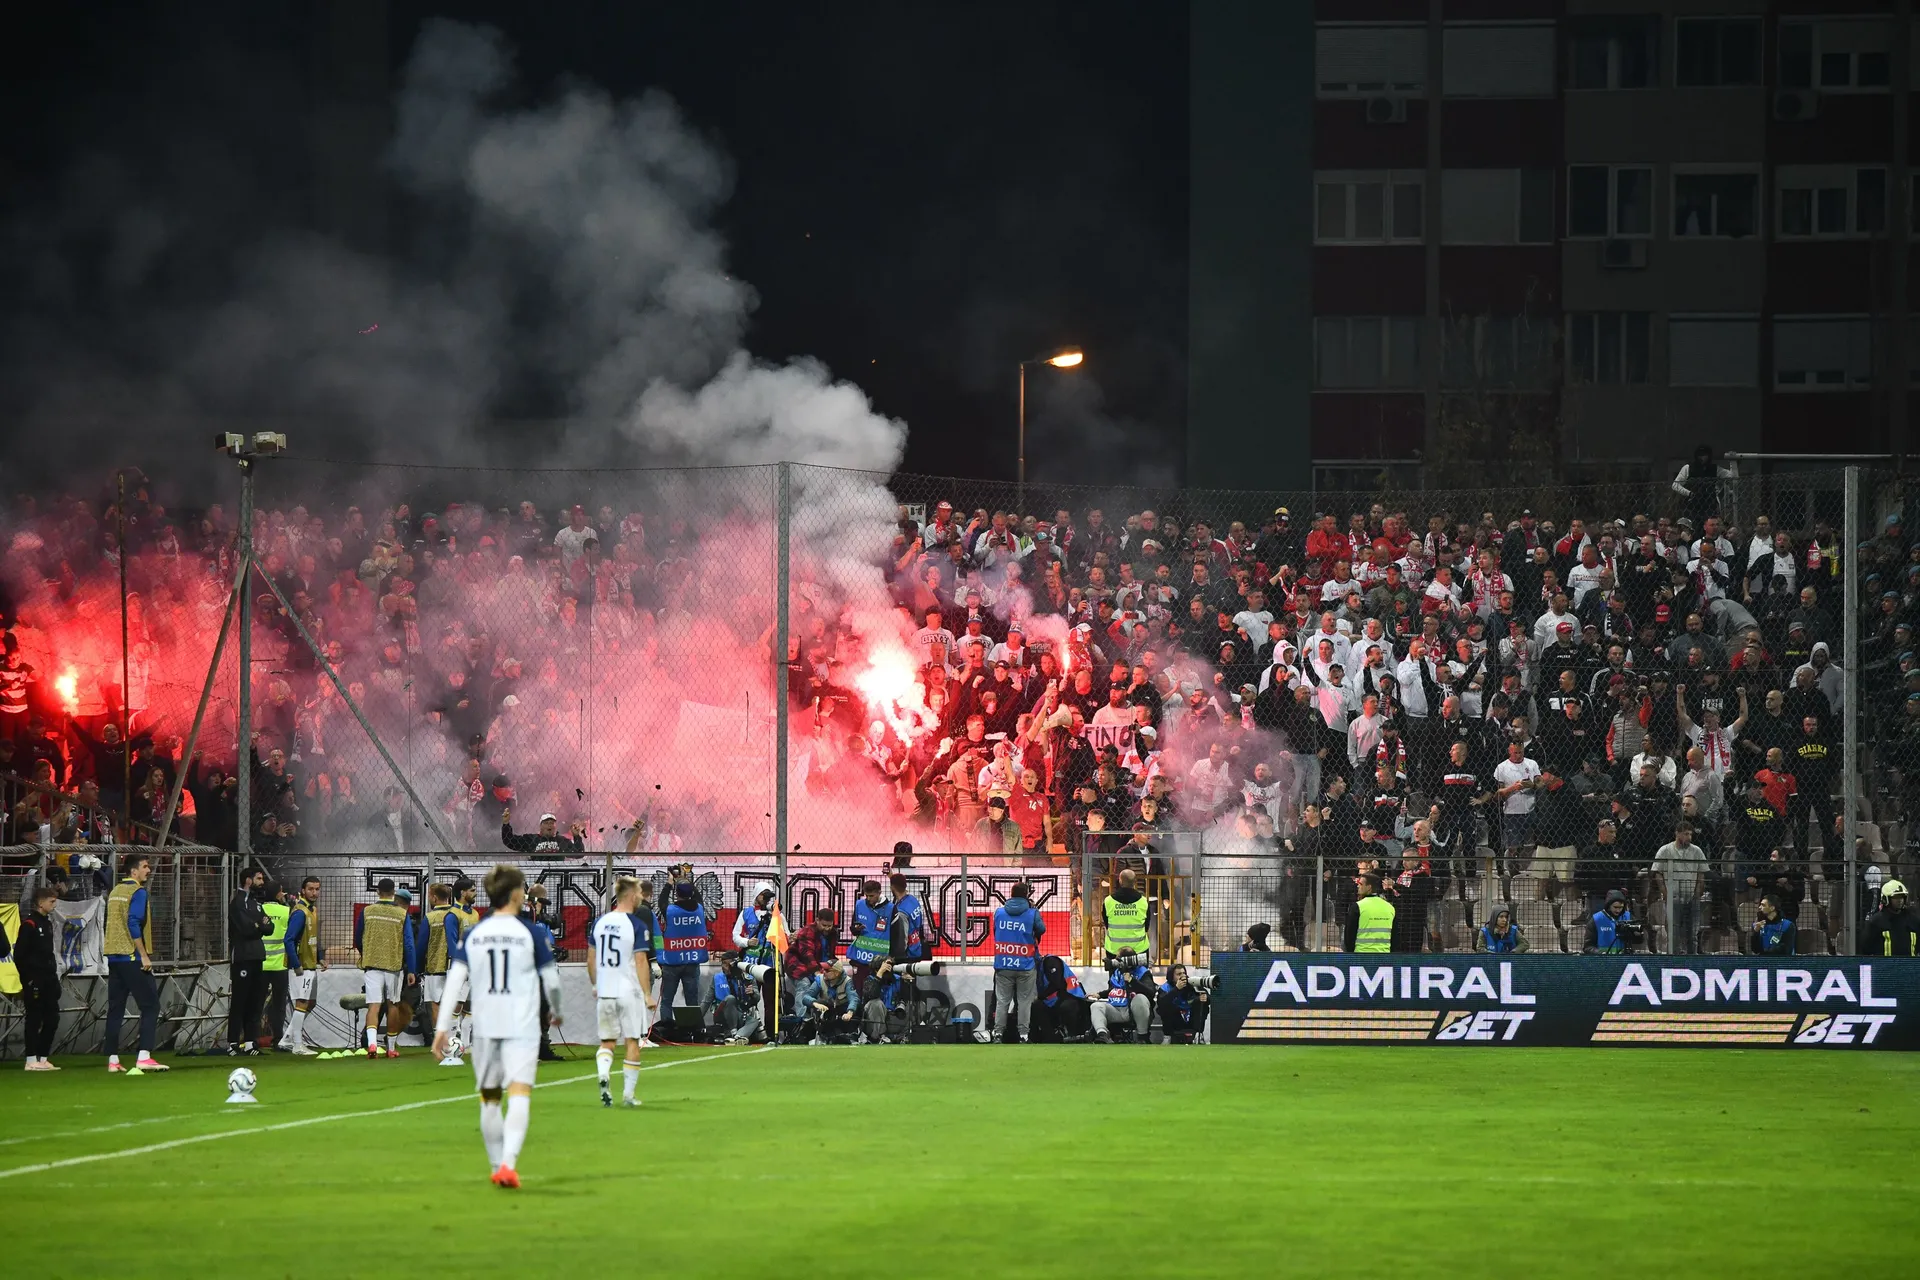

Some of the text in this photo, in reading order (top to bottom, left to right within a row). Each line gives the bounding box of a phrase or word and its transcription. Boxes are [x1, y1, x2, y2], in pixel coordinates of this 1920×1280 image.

[673, 916, 702, 926] UEFA
[999, 921, 1026, 932] UEFA
[670, 938, 706, 949] PHOTO
[995, 943, 1029, 955] PHOTO
[600, 934, 621, 967] 15
[679, 951, 699, 961] 113
[1002, 957, 1021, 968] 124
[487, 949, 511, 994] 11
[302, 978, 311, 989] 14
[1254, 960, 1536, 1004] ADMIRAL
[1608, 963, 1897, 1007] ADMIRAL
[1435, 1010, 1536, 1041] BET
[1793, 1014, 1897, 1044] BET
